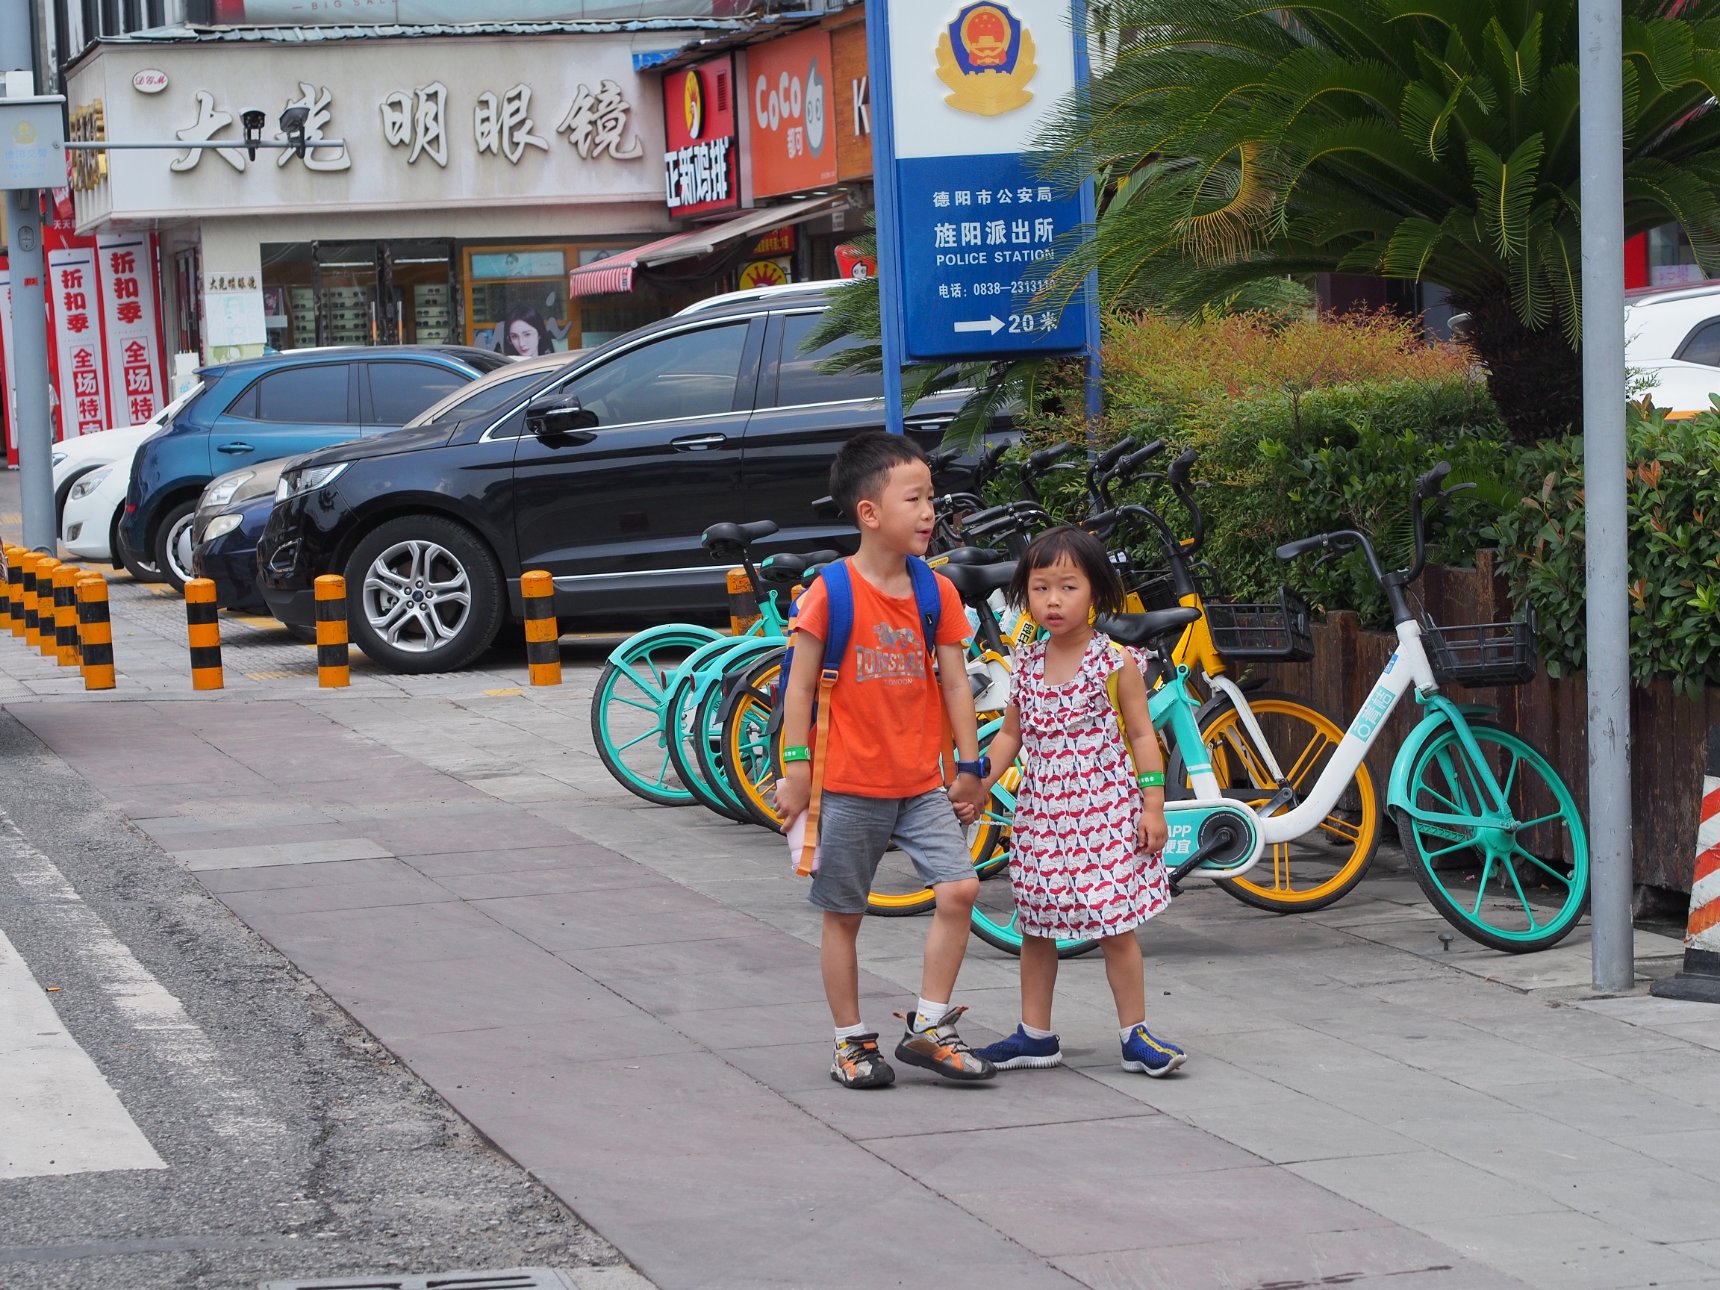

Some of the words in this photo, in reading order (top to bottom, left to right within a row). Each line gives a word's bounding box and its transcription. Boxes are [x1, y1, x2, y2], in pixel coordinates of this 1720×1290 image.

[170, 79, 644, 173] 大光明眼镜
[664, 137, 728, 208] 正新鸡排
[933, 186, 1052, 208] 德阳市公安局
[53, 219, 76, 230] 天天
[934, 217, 1054, 249] 旌阳派出所
[936, 252, 988, 266] POLICE
[994, 248, 1055, 263] STATION
[61, 268, 89, 333] 折扣季
[110, 250, 142, 324] 折扣季
